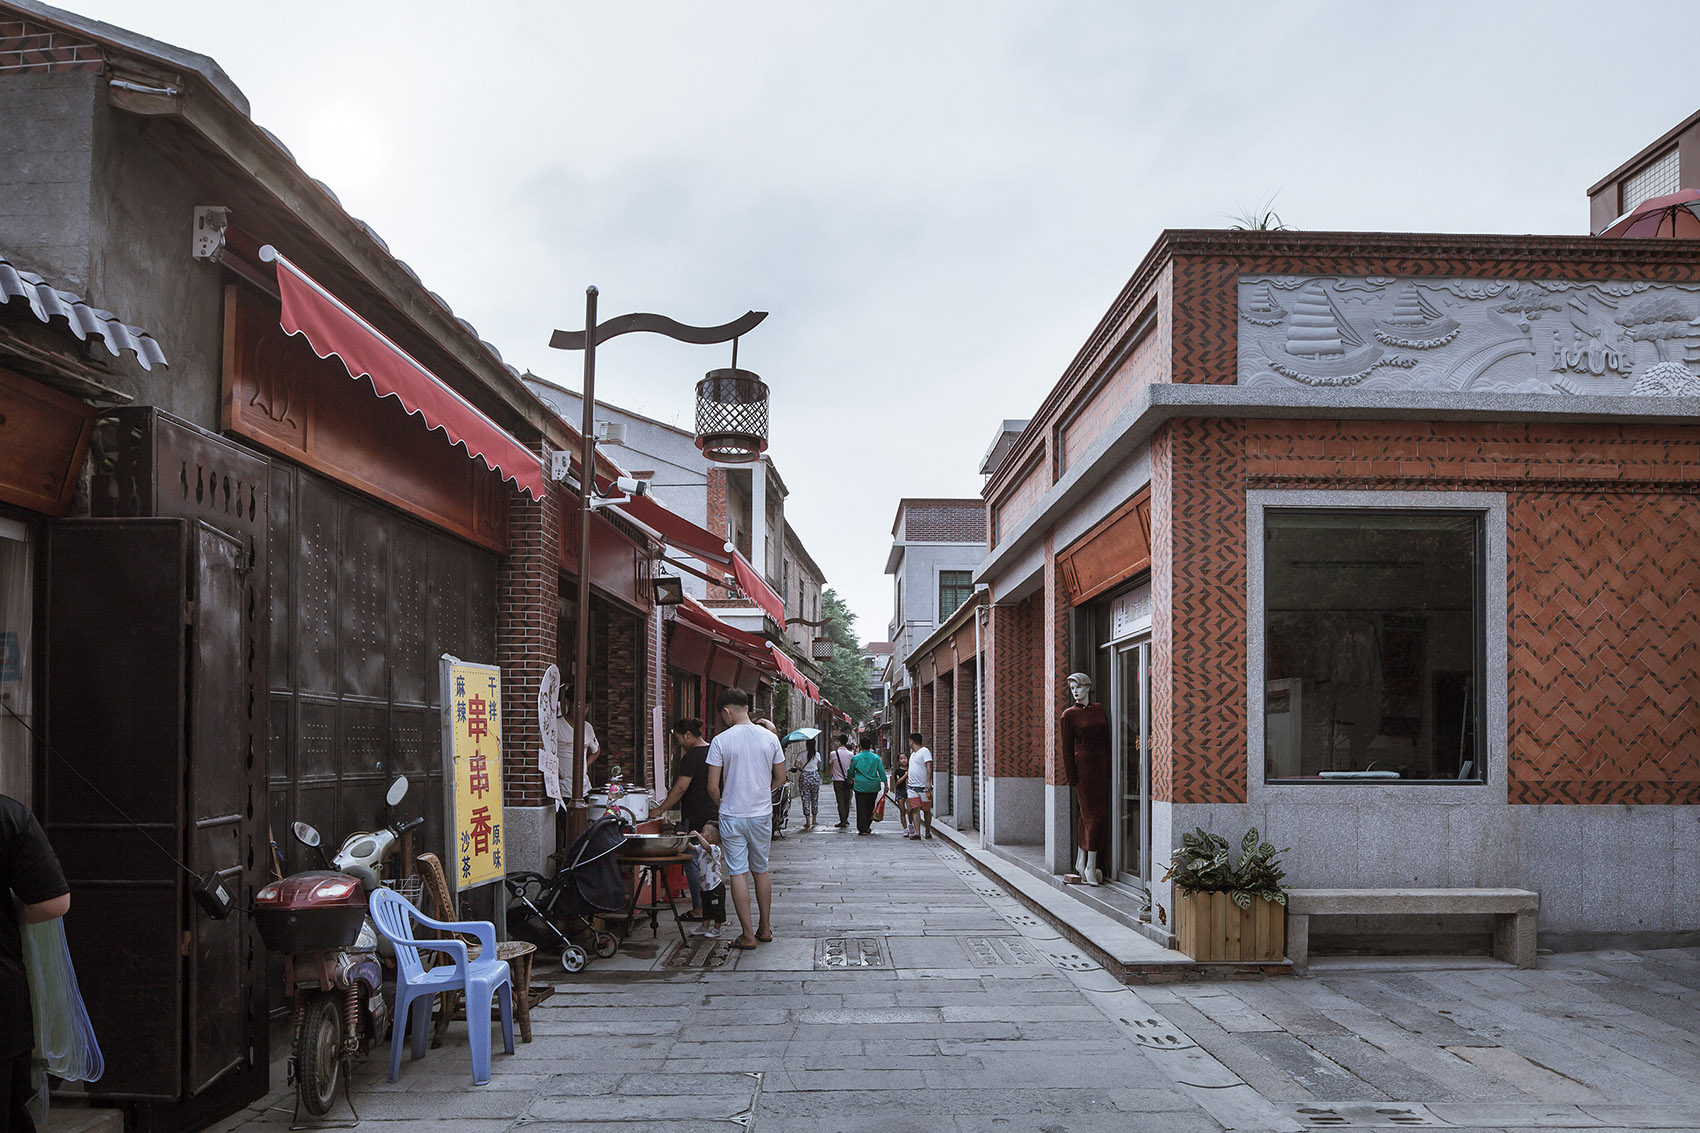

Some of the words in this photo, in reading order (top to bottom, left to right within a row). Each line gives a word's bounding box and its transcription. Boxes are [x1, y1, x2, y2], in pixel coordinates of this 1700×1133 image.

[456, 675, 467, 723] 麻辣
[488, 676, 498, 722] 干拌
[468, 693, 492, 857] 串串香
[461, 830, 471, 879] 沙茶
[492, 824, 502, 870] 原味
